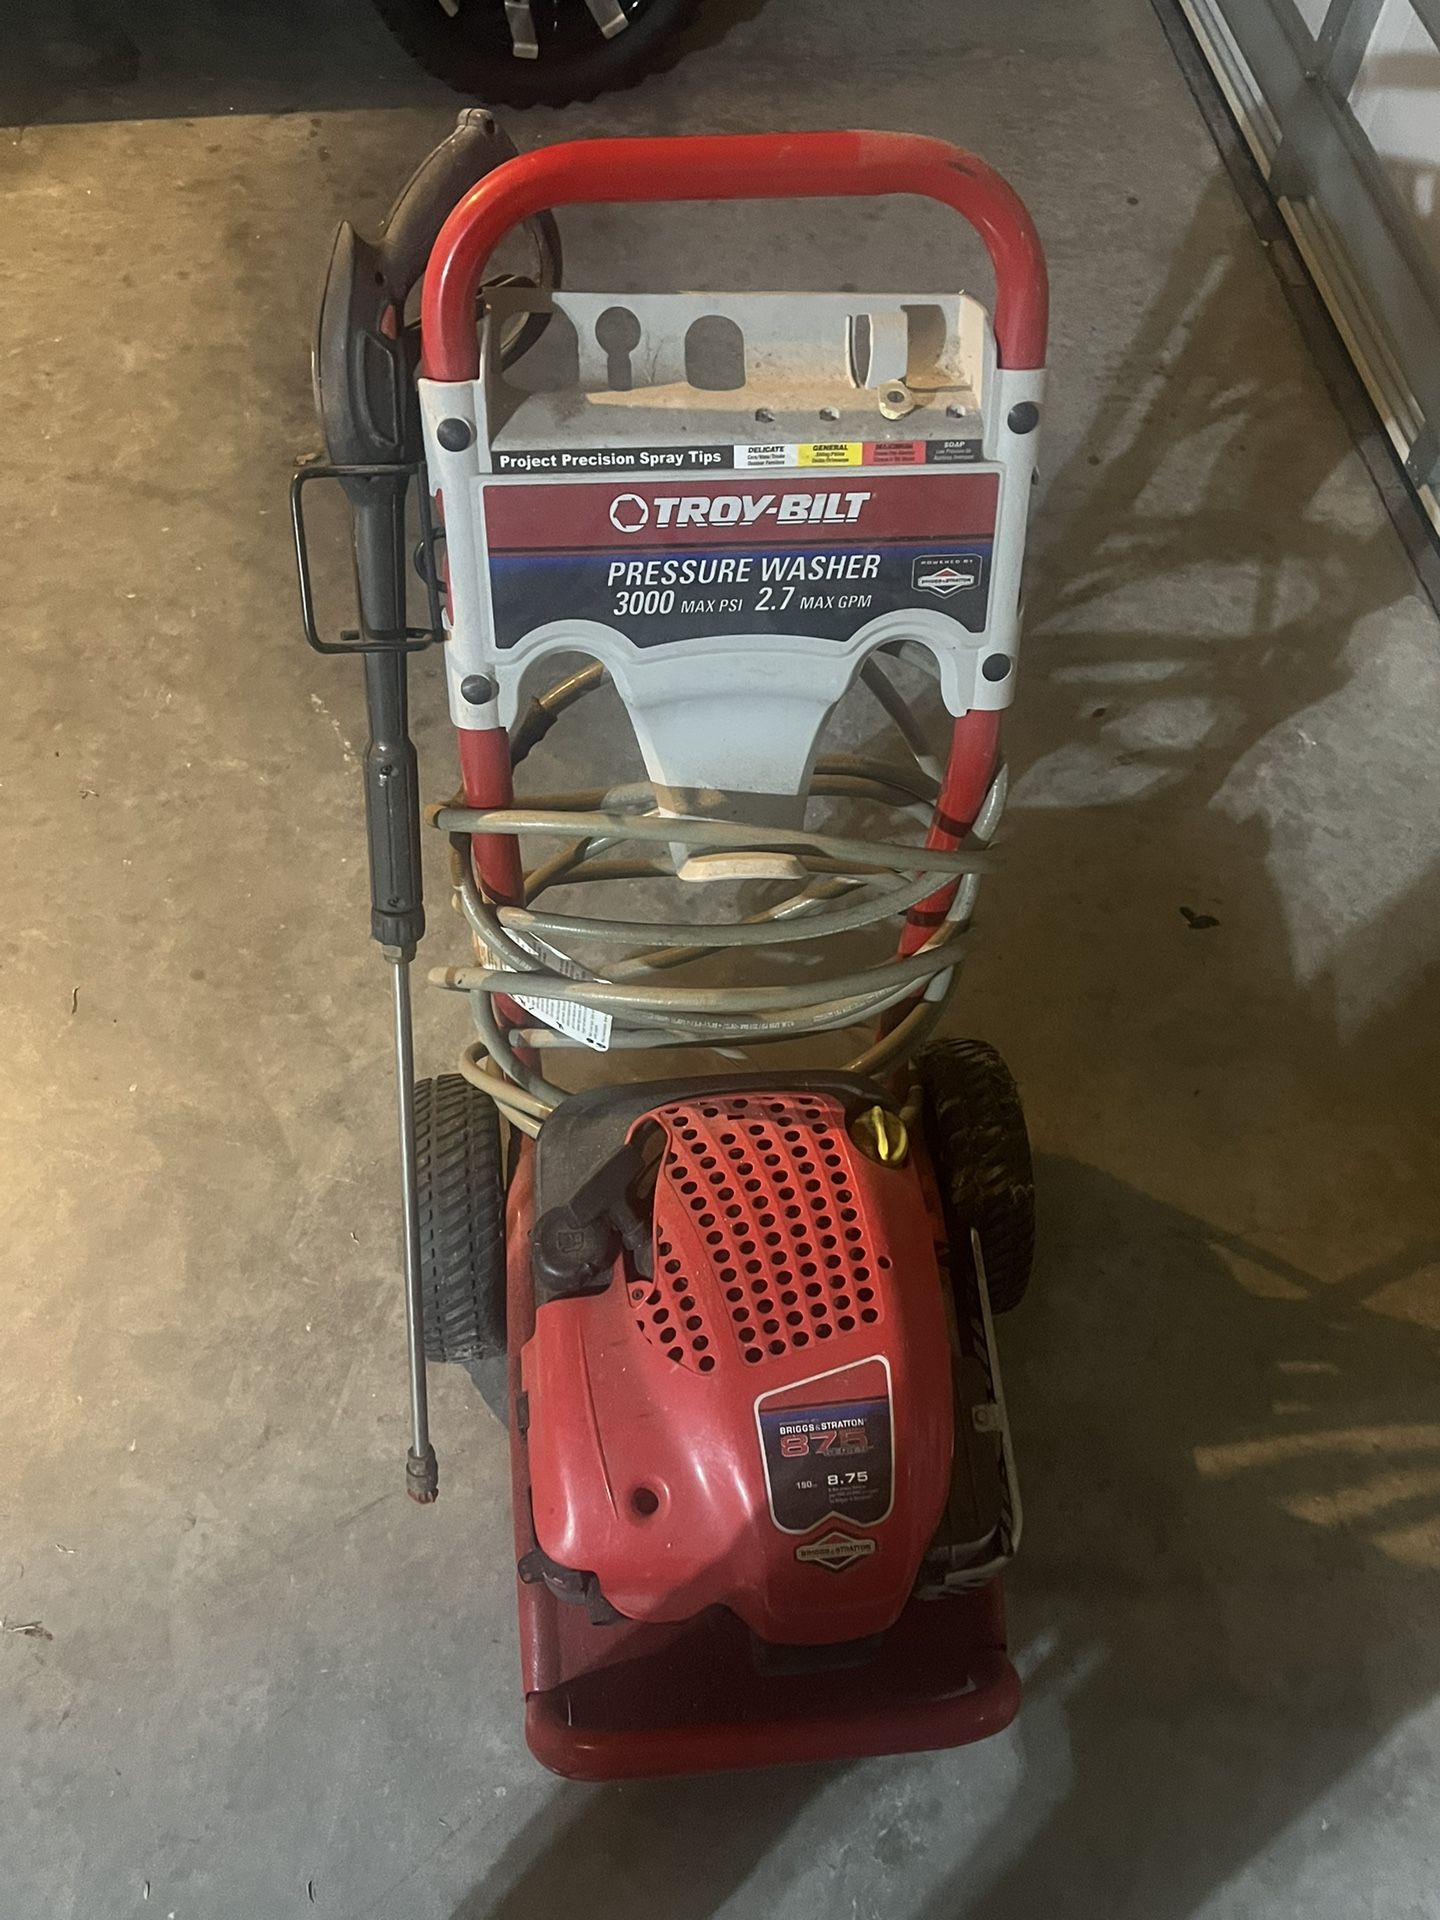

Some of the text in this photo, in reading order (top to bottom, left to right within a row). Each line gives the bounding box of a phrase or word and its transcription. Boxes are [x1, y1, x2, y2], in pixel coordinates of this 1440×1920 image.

[499, 450, 722, 470] Project Precision Spray Tips
[944, 441, 966, 449] SOAP
[653, 492, 871, 528] TROY-BILT
[607, 554, 881, 586] PRESSURE WASHER
[613, 586, 872, 616] 3000 MAX PSI 2.7 MAX GPM
[780, 1428, 869, 1458] 875
[827, 1471, 869, 1486] 8.75
